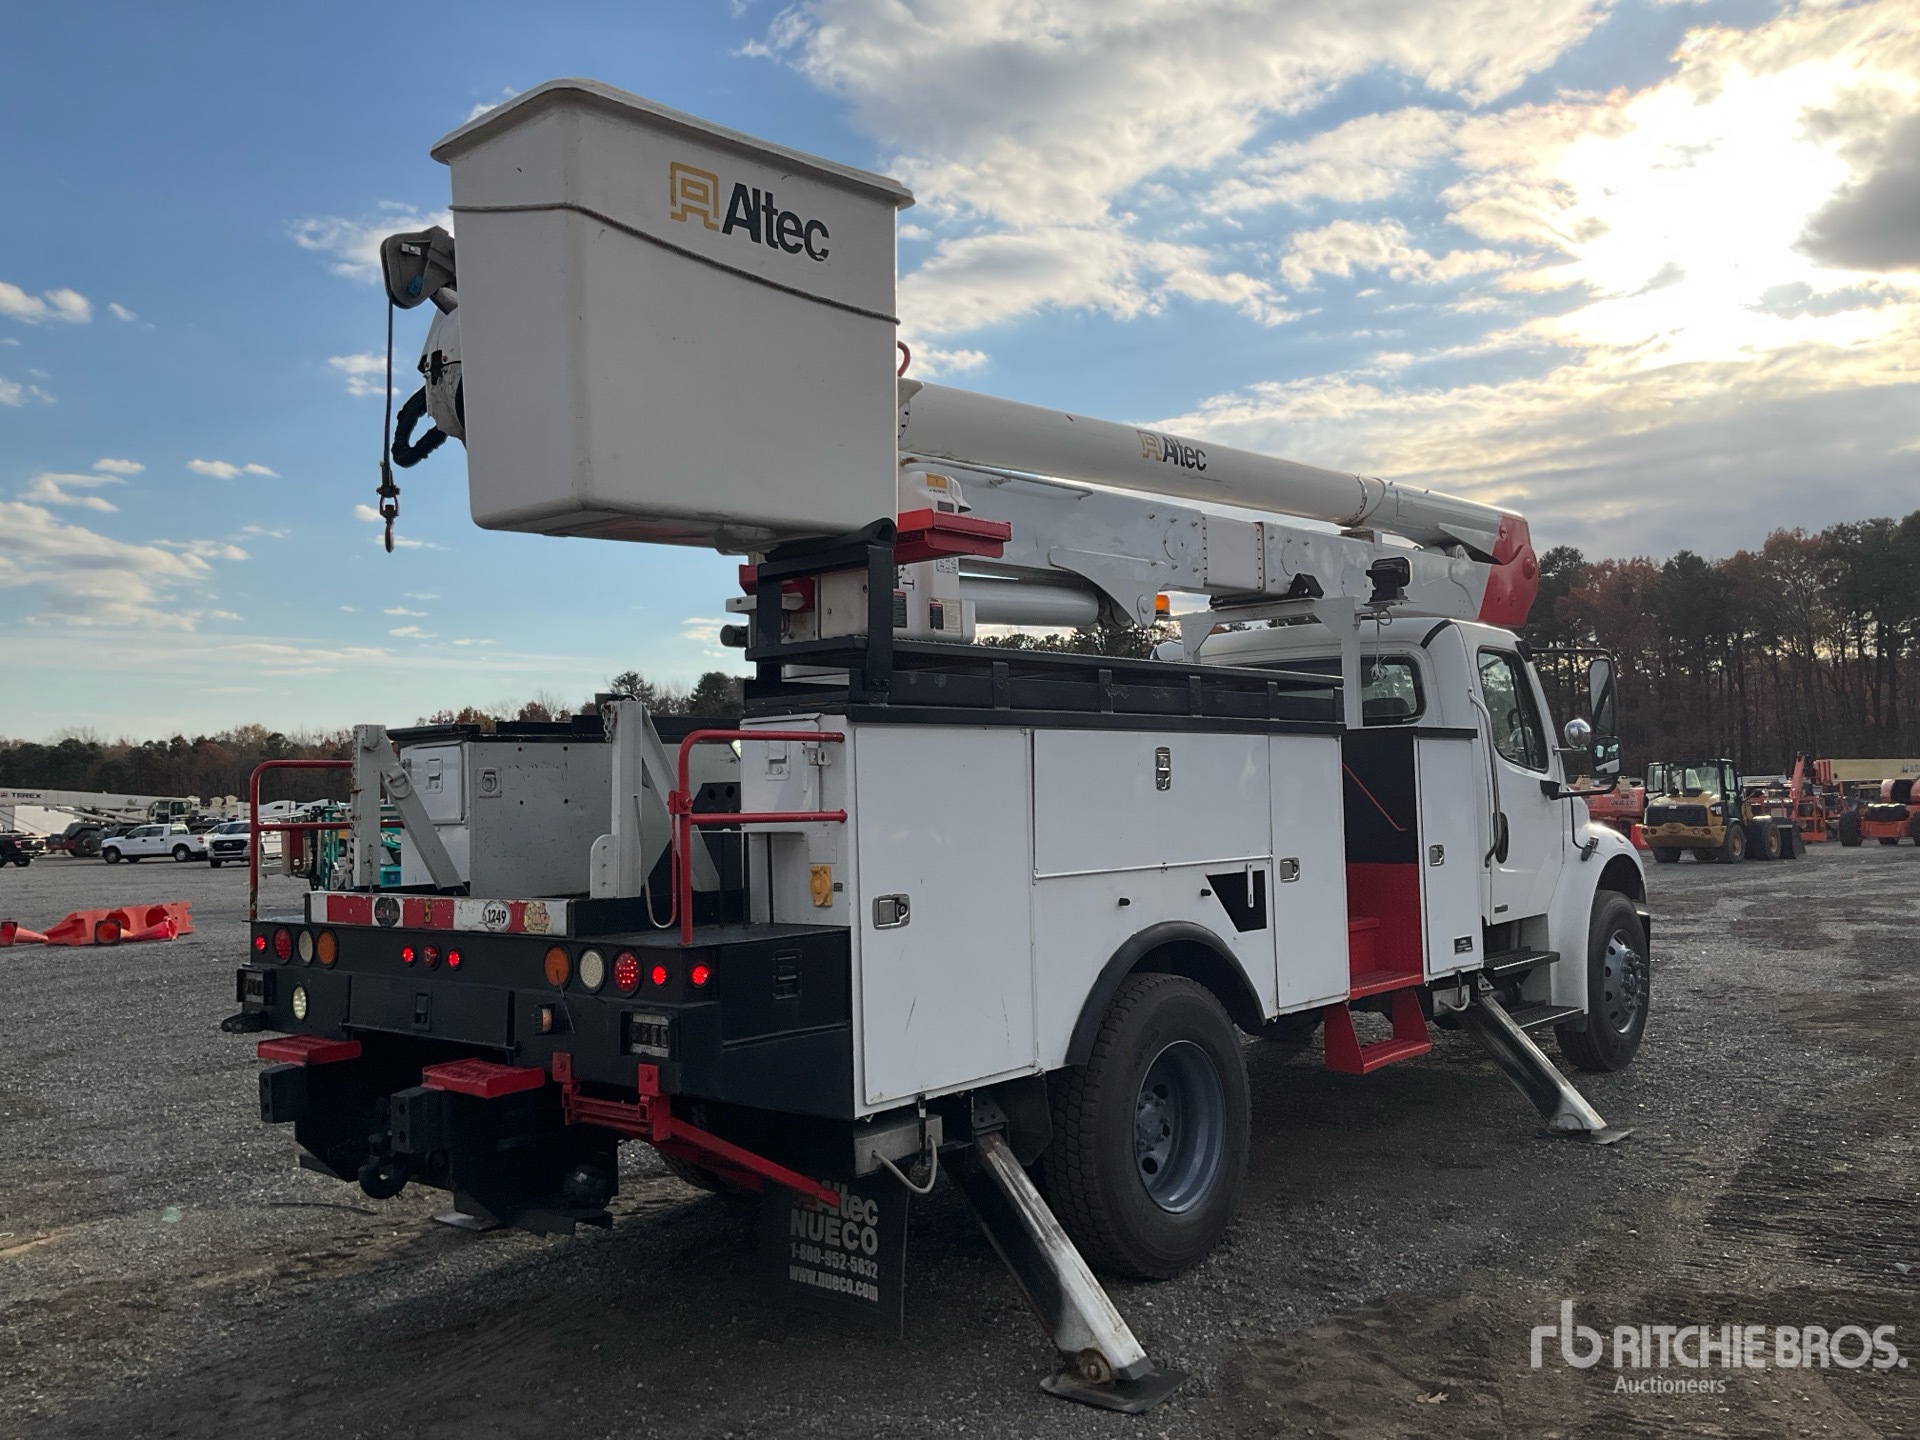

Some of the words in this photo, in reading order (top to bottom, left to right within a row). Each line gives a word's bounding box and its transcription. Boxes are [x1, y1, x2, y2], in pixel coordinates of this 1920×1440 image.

[722, 182, 830, 262] Altec
[1162, 436, 1207, 471] Altec
[487, 909, 507, 924] 1249
[790, 1208, 878, 1255] NUECO
[789, 1264, 878, 1302] www.nueco.com
